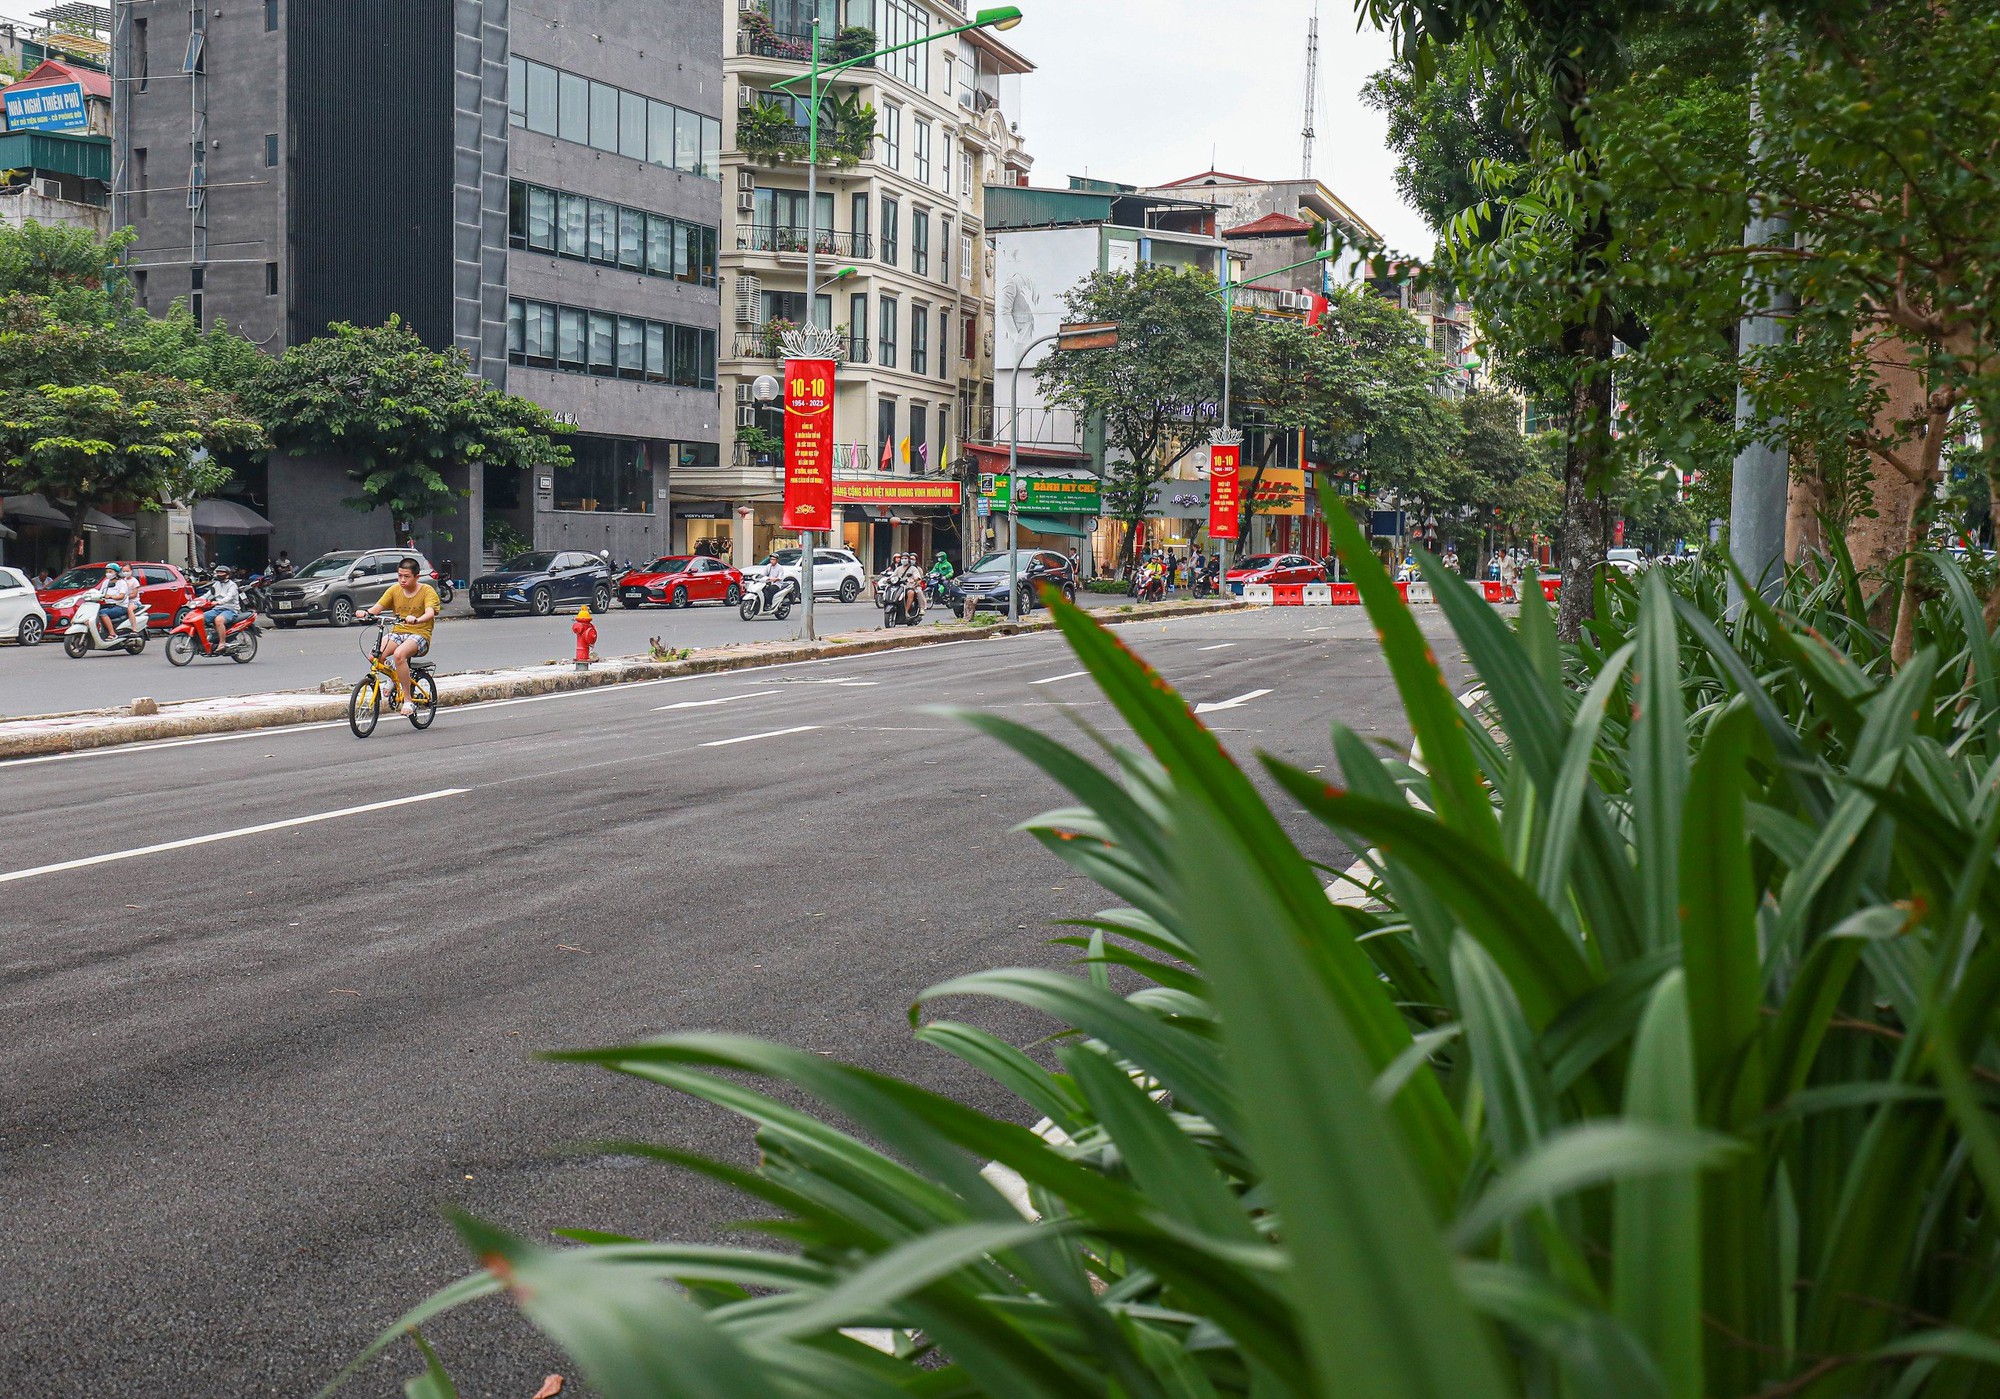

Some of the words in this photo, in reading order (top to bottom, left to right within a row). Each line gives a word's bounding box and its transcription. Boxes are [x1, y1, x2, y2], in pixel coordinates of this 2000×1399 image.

[8, 97, 24, 116] NHÀ
[23, 92, 42, 114] NGHỈ
[42, 92, 64, 112] THIÊN
[64, 88, 80, 109] PHÚ
[791, 378, 825, 398] 10-10
[1214, 455, 1233, 467] 10-10
[863, 485, 873, 497] SẢN
[874, 485, 884, 499] VIỆT
[1033, 479, 1060, 492] BÁNH
[1061, 480, 1078, 492] MỲ
